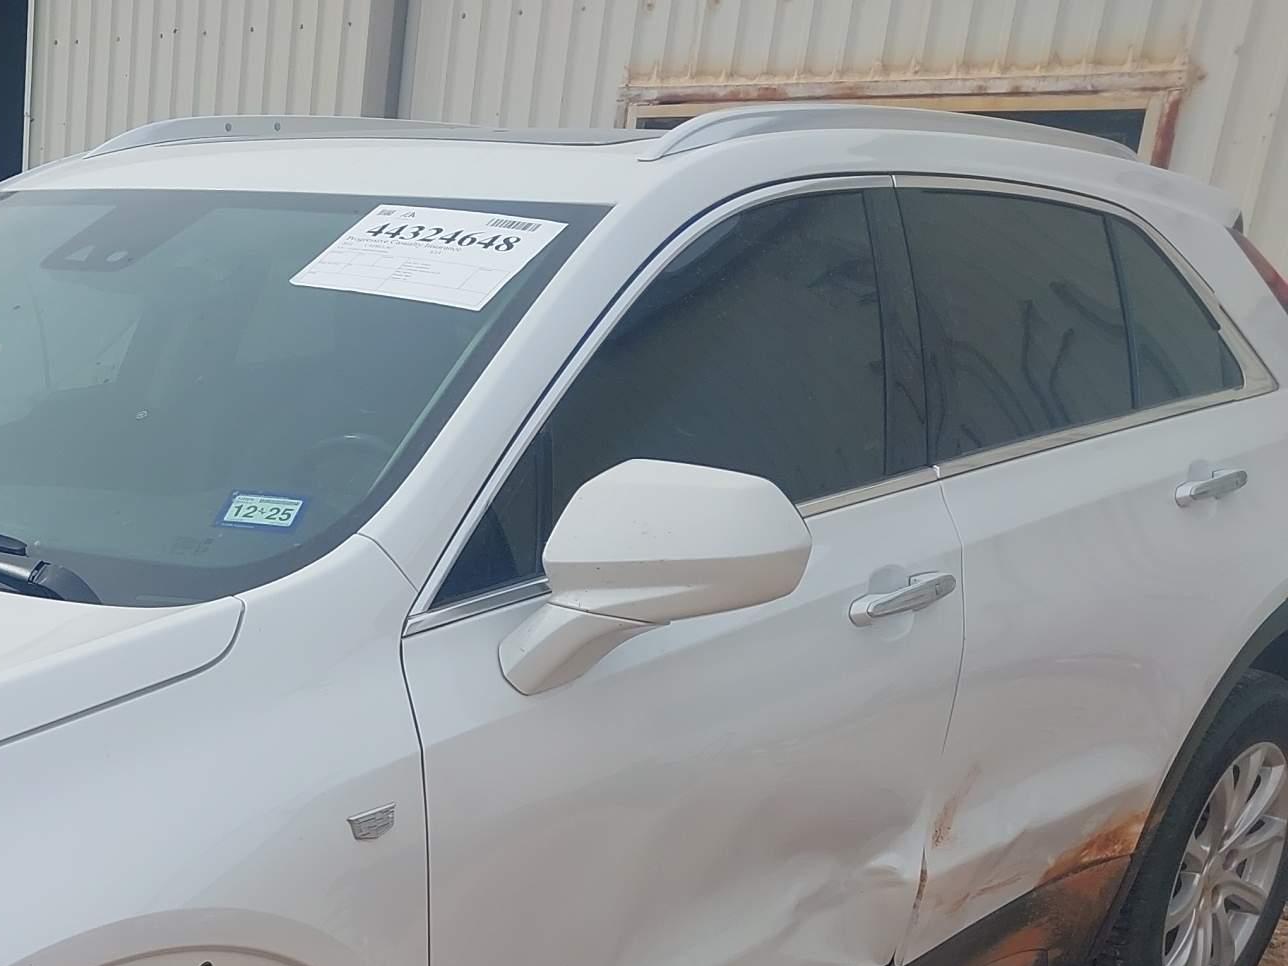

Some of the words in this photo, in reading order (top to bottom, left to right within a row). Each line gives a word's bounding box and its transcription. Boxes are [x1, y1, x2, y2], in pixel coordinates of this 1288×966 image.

[366, 223, 521, 252] 44324648
[233, 504, 258, 519] 12
[265, 507, 295, 522] 25
